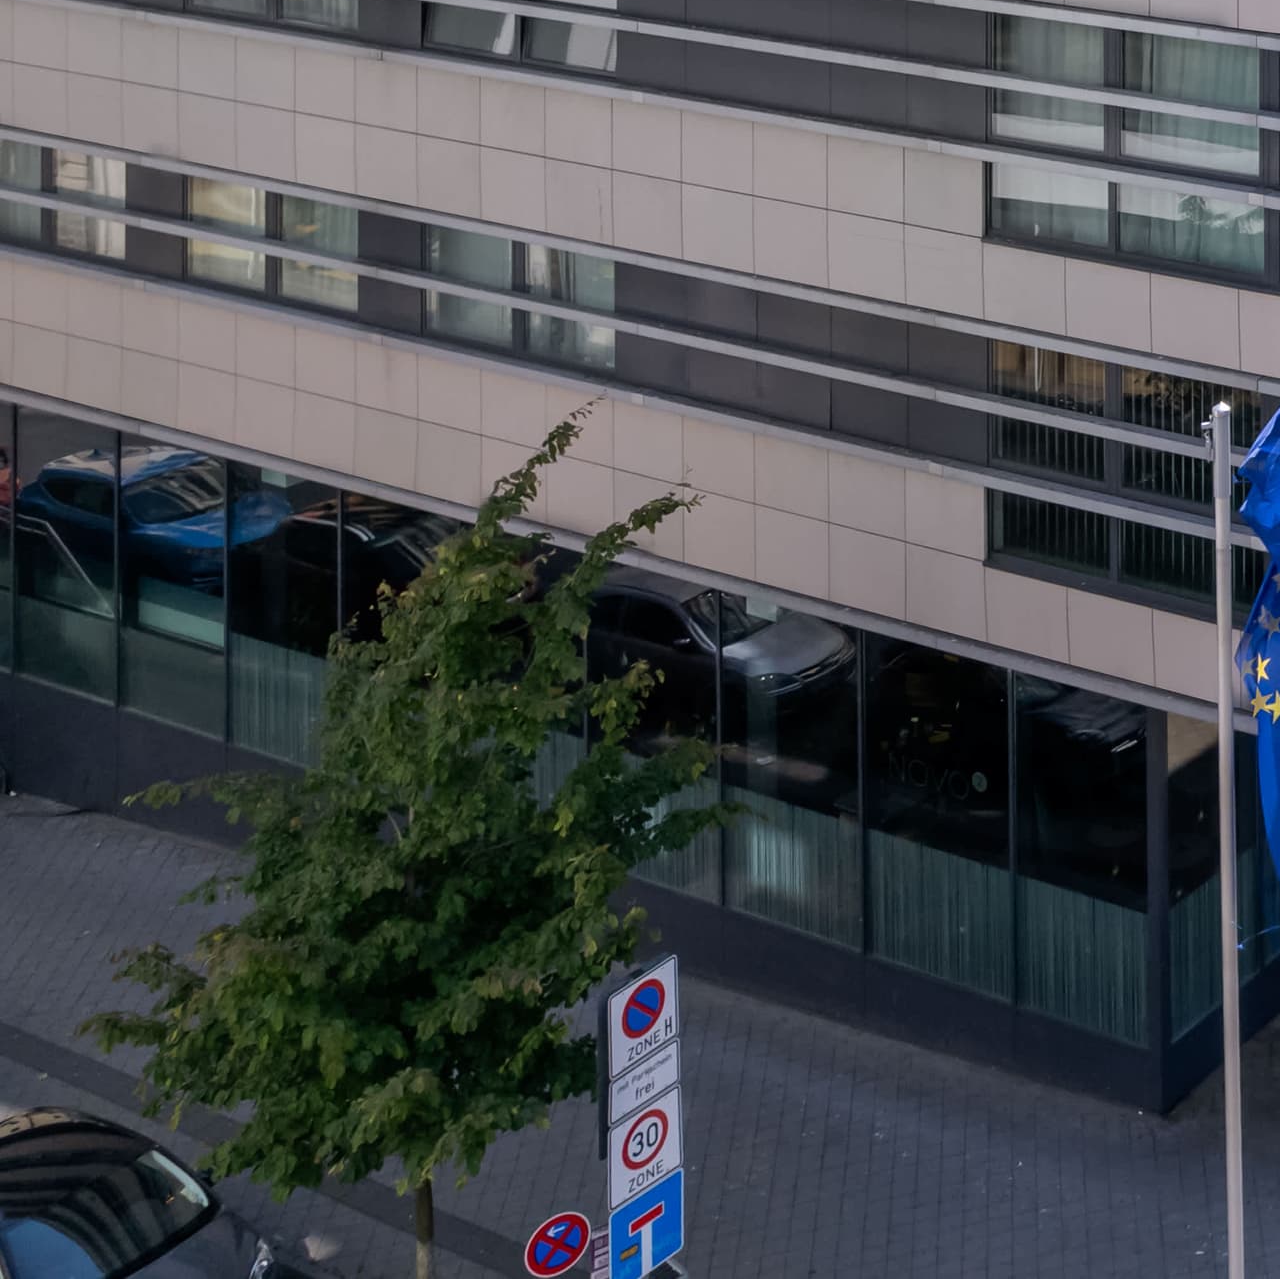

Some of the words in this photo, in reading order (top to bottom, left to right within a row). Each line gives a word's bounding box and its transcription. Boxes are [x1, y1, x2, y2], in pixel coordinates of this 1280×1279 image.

[627, 1029, 661, 1062] ZONE
[664, 1015, 673, 1038] H
[635, 1076, 655, 1100] frei
[631, 1122, 659, 1157] 30
[628, 1159, 665, 1193] ZONE
